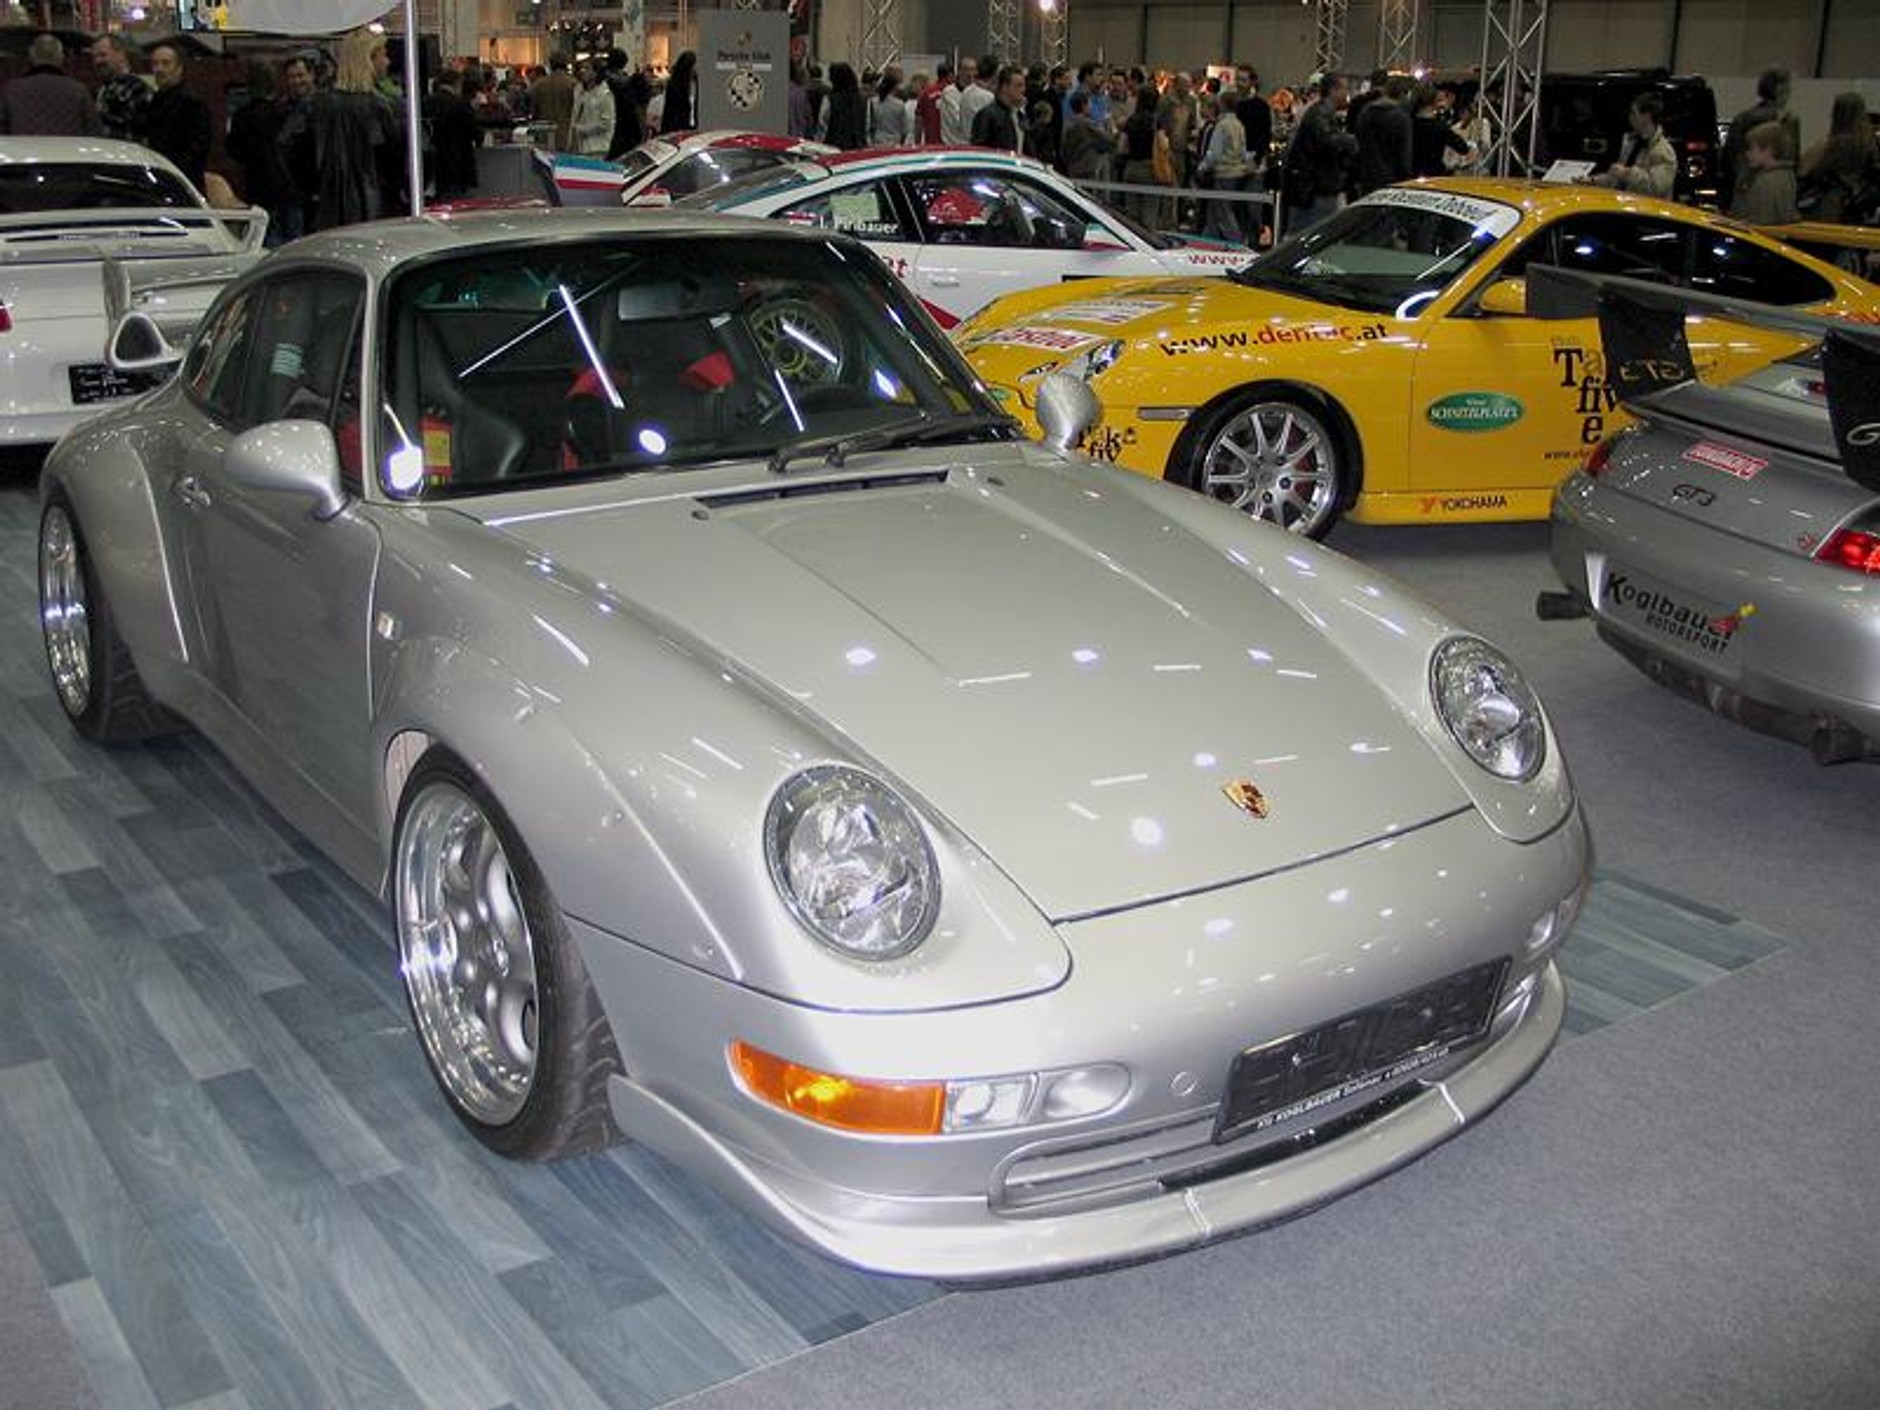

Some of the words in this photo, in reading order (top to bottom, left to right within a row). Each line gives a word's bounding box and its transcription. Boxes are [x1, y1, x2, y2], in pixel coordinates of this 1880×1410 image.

[1441, 495, 1508, 511] YOKOHAMA
[1673, 484, 1716, 506] GT3
[1646, 611, 1728, 653] MOTORSPORT
